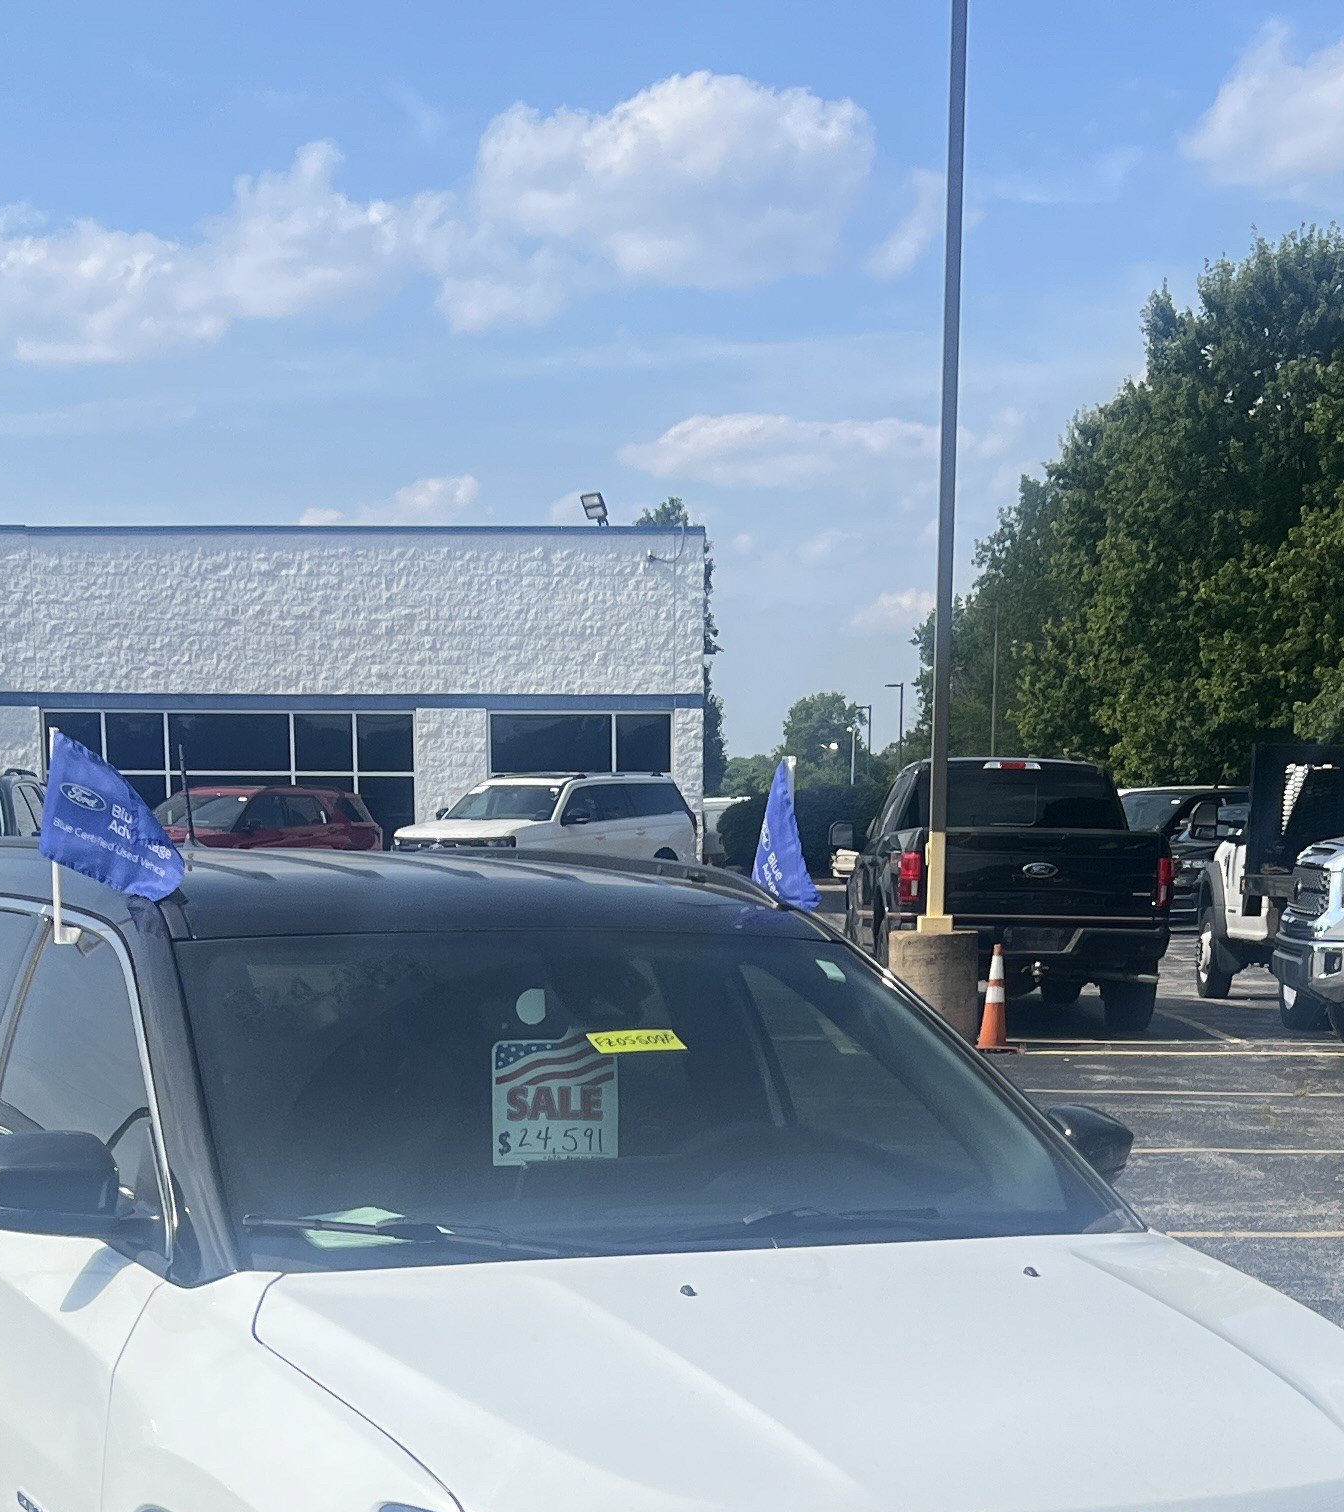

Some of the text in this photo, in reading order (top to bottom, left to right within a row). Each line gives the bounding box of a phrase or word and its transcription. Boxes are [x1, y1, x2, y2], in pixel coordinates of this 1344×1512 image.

[67, 786, 98, 808] Ford
[112, 804, 133, 824] Blu
[767, 852, 783, 882] Blue
[506, 1086, 603, 1121] SALE
